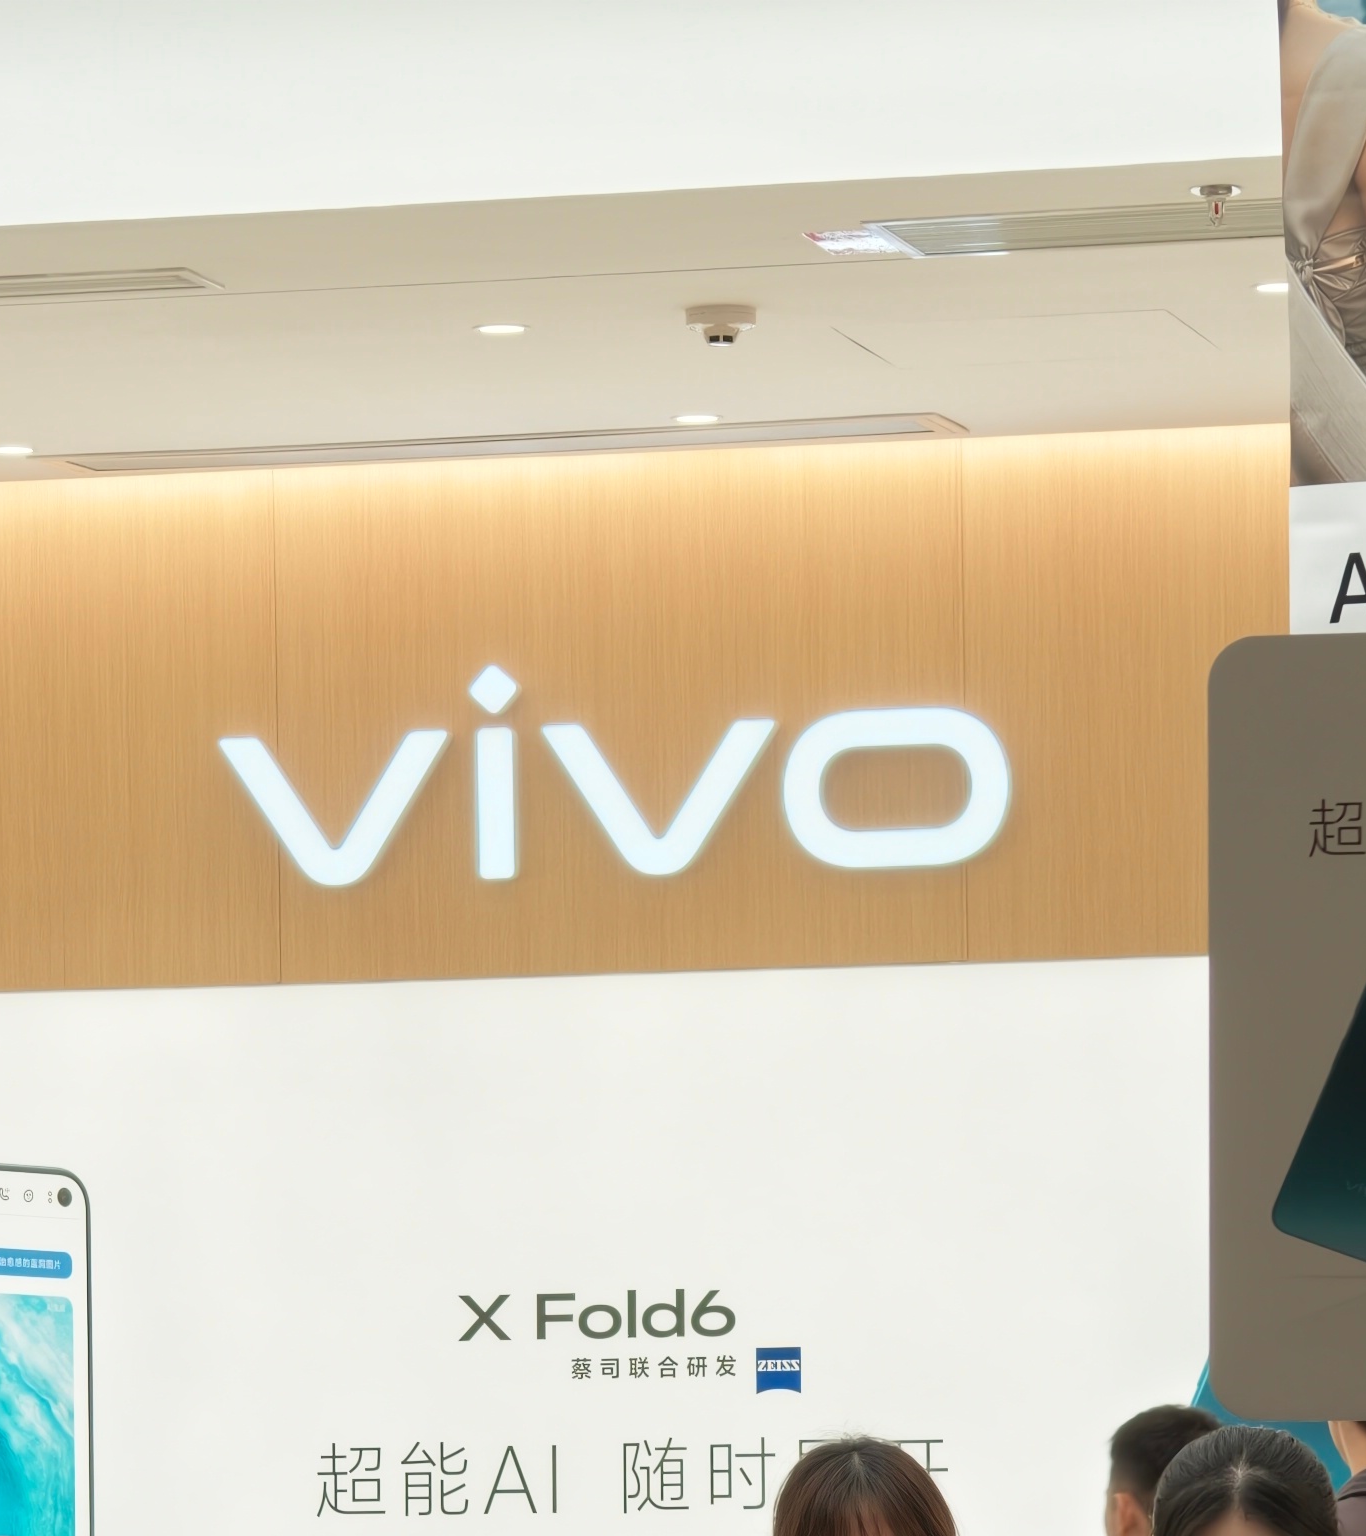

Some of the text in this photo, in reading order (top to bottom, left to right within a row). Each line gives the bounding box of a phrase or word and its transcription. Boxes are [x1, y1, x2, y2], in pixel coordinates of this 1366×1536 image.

[218, 664, 1012, 887] vivo
[458, 1288, 736, 1341] X Fold6
[571, 1355, 737, 1380] 蔡司联合研发
[757, 1359, 800, 1372] ZEISS
[316, 1440, 558, 1517] 超能AI
